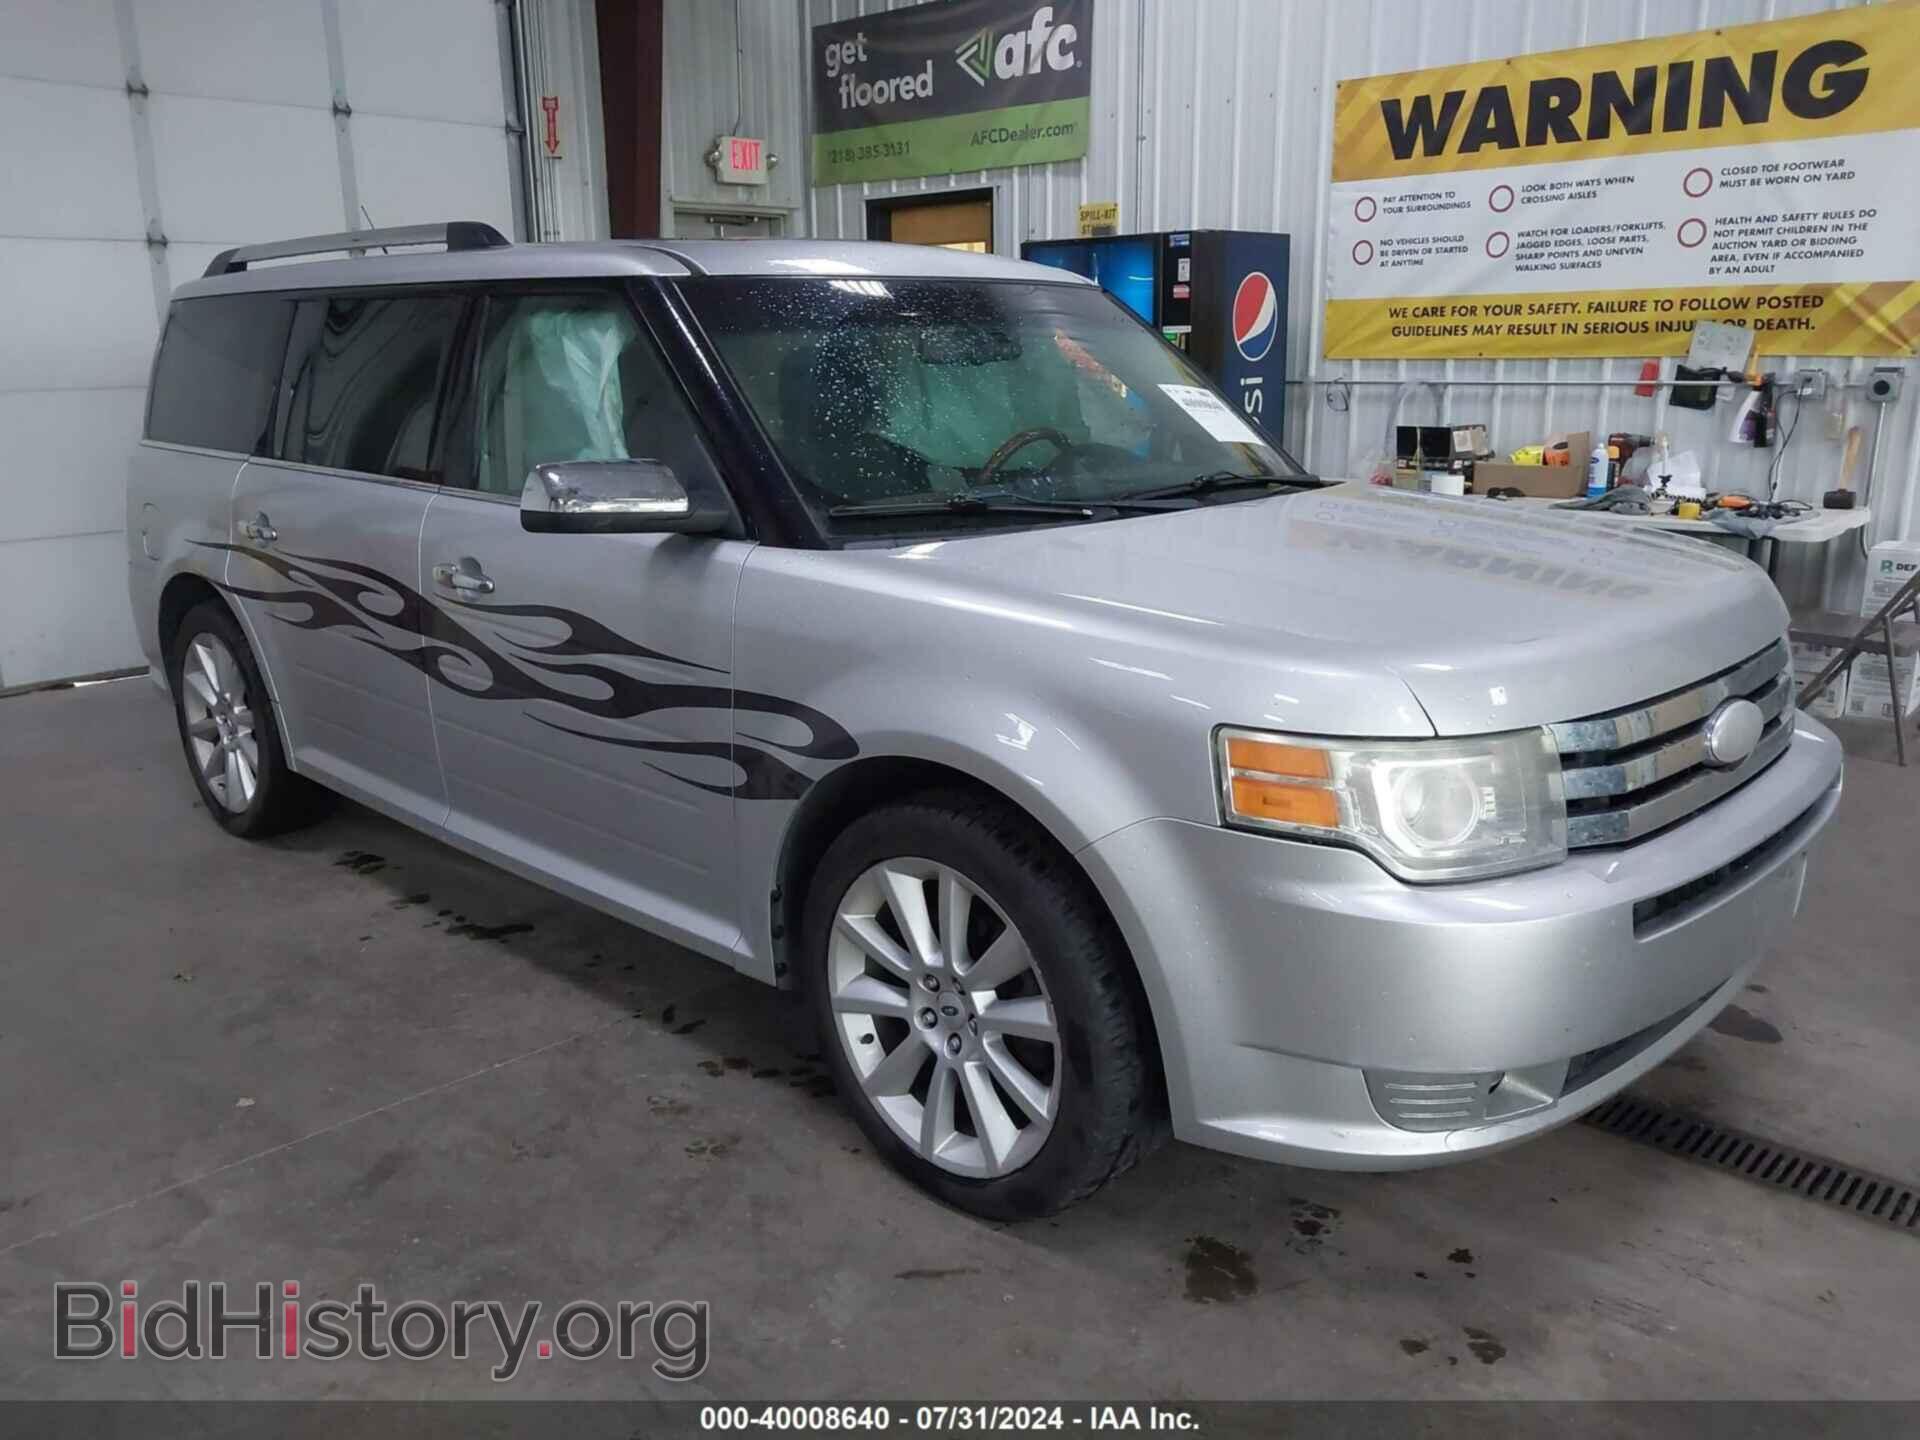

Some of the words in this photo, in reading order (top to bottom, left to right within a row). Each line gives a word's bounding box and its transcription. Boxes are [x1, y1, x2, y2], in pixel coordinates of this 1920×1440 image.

[994, 6, 1077, 80] afc
[825, 32, 868, 77] get
[838, 59, 933, 110] floored
[1381, 39, 1870, 161] WARNING
[969, 123, 1074, 147] AFCDealer.com
[731, 140, 760, 170] EXIT
[1721, 166, 1758, 176] CLOSED
[1761, 163, 1780, 173] TOE
[1783, 159, 1845, 171] FOOTWEAR
[1522, 184, 1546, 193] LOOK
[1549, 181, 1573, 191] BOTH
[1576, 178, 1601, 188] WAYS
[1605, 175, 1635, 186] WHEN
[1719, 179, 1746, 189] MUST
[1750, 178, 1762, 187] BE
[1765, 175, 1799, 185] WORN
[1803, 174, 1822, 183] ON
[1825, 171, 1855, 181] YARD
[1399, 193, 1442, 203] ATTENTION
[1445, 191, 1456, 199] TO
[1521, 193, 1565, 205] CROSSING
[1568, 190, 1597, 200] AISLES
[1383, 206, 1403, 215] YOUR
[1406, 201, 1471, 213] SURROUNDINGS
[1715, 216, 1751, 226] HEALTH
[1755, 214, 1778, 224] AND
[1781, 212, 1818, 223] SAFETY
[1822, 210, 1855, 220] RULES
[1858, 208, 1877, 218] DO
[1517, 229, 1548, 238] WATCH
[1550, 227, 1568, 236] FOR
[1571, 221, 1666, 235] LOADERS/FORKLIFTS,
[1713, 229, 1735, 238] NOT
[1738, 227, 1774, 237] PERMIT
[1776, 225, 1828, 235] CHILDREN
[1831, 223, 1844, 232] IN
[1847, 222, 1869, 231] THE
[1396, 237, 1430, 245] VEHICLES
[1432, 235, 1464, 243] SHOULD
[1516, 240, 1551, 250] JAGGED
[1554, 238, 1584, 247] EDGES,
[1587, 236, 1616, 246] LOOSE
[1619, 234, 1649, 244] PARTS,
[1711, 241, 1758, 250] AUCTION
[1761, 239, 1788, 249] YARD
[1791, 238, 1806, 247] OR
[1809, 236, 1858, 246] BIDDING
[1391, 248, 1419, 256] DRIVEN
[1421, 247, 1432, 255] OR
[1435, 246, 1469, 254] STARTED
[1515, 252, 1545, 261] SHARP
[1547, 250, 1579, 259] POINTS
[1582, 249, 1603, 258] AND
[1605, 247, 1644, 256] UNEVEN
[1710, 254, 1740, 264] AREA,
[1743, 252, 1769, 262] EVEN
[1772, 252, 1781, 261] IF
[1784, 249, 1864, 260] ACCOMPANIED
[1391, 259, 1424, 267] ANYTIME
[1515, 262, 1557, 272] WALKING
[1559, 260, 1602, 270] SURFACES
[1708, 266, 1721, 275] BY
[1724, 265, 1741, 274] AN
[1743, 264, 1776, 274] ADULT
[1389, 307, 1408, 319] WE
[1412, 306, 1446, 318] CARE
[1451, 305, 1478, 317] FOR
[1483, 303, 1523, 317] YOUR
[1527, 302, 1582, 316] SAFETY.
[1587, 300, 1647, 314] FAILURE
[1653, 299, 1674, 312] TO
[1679, 296, 1751, 312] FOLLOW
[1756, 295, 1824, 309] POSTED
[1391, 324, 1468, 338] GUIDELINES
[1472, 324, 1503, 337] MAY
[1507, 322, 1557, 336] RESULT
[1561, 322, 1578, 335] IN
[1583, 320, 1649, 335] SERIOUS
[1655, 318, 1716, 333] INJU
[1754, 317, 1816, 332] DEATH.
